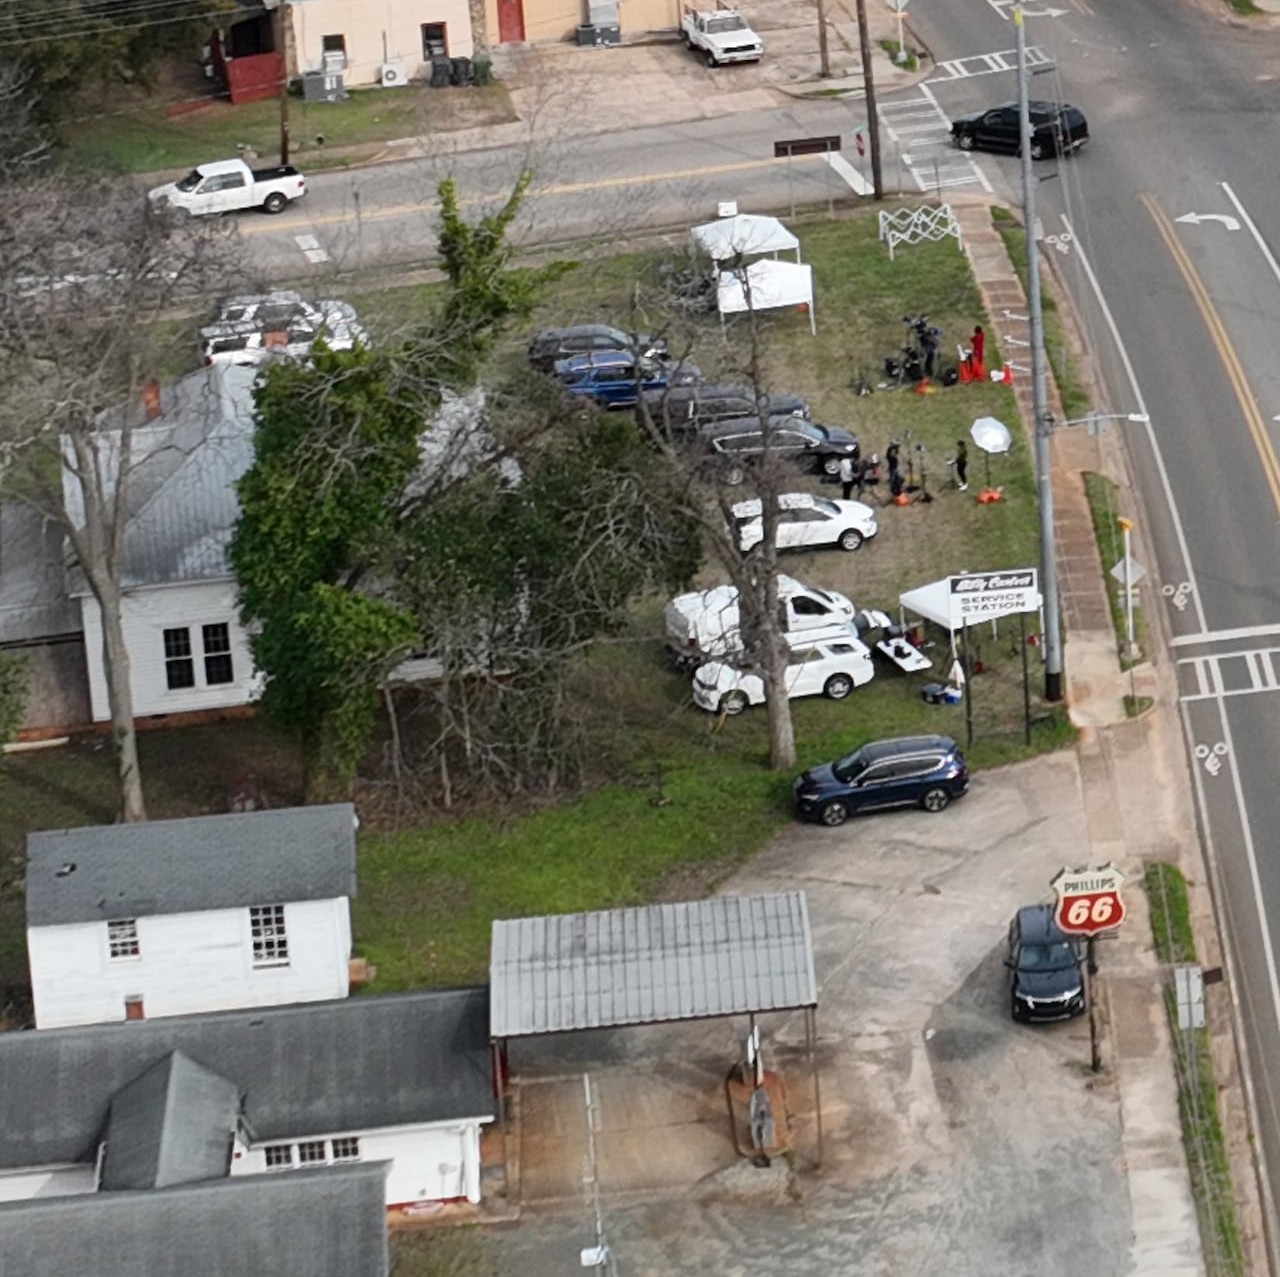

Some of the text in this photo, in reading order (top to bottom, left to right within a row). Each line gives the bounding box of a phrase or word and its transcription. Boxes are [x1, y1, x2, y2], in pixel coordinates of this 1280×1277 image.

[961, 592, 1025, 604] SERVICE
[961, 601, 1026, 613] STATION
[1064, 877, 1115, 892] PHILLIPS
[1067, 896, 1114, 925] 66
